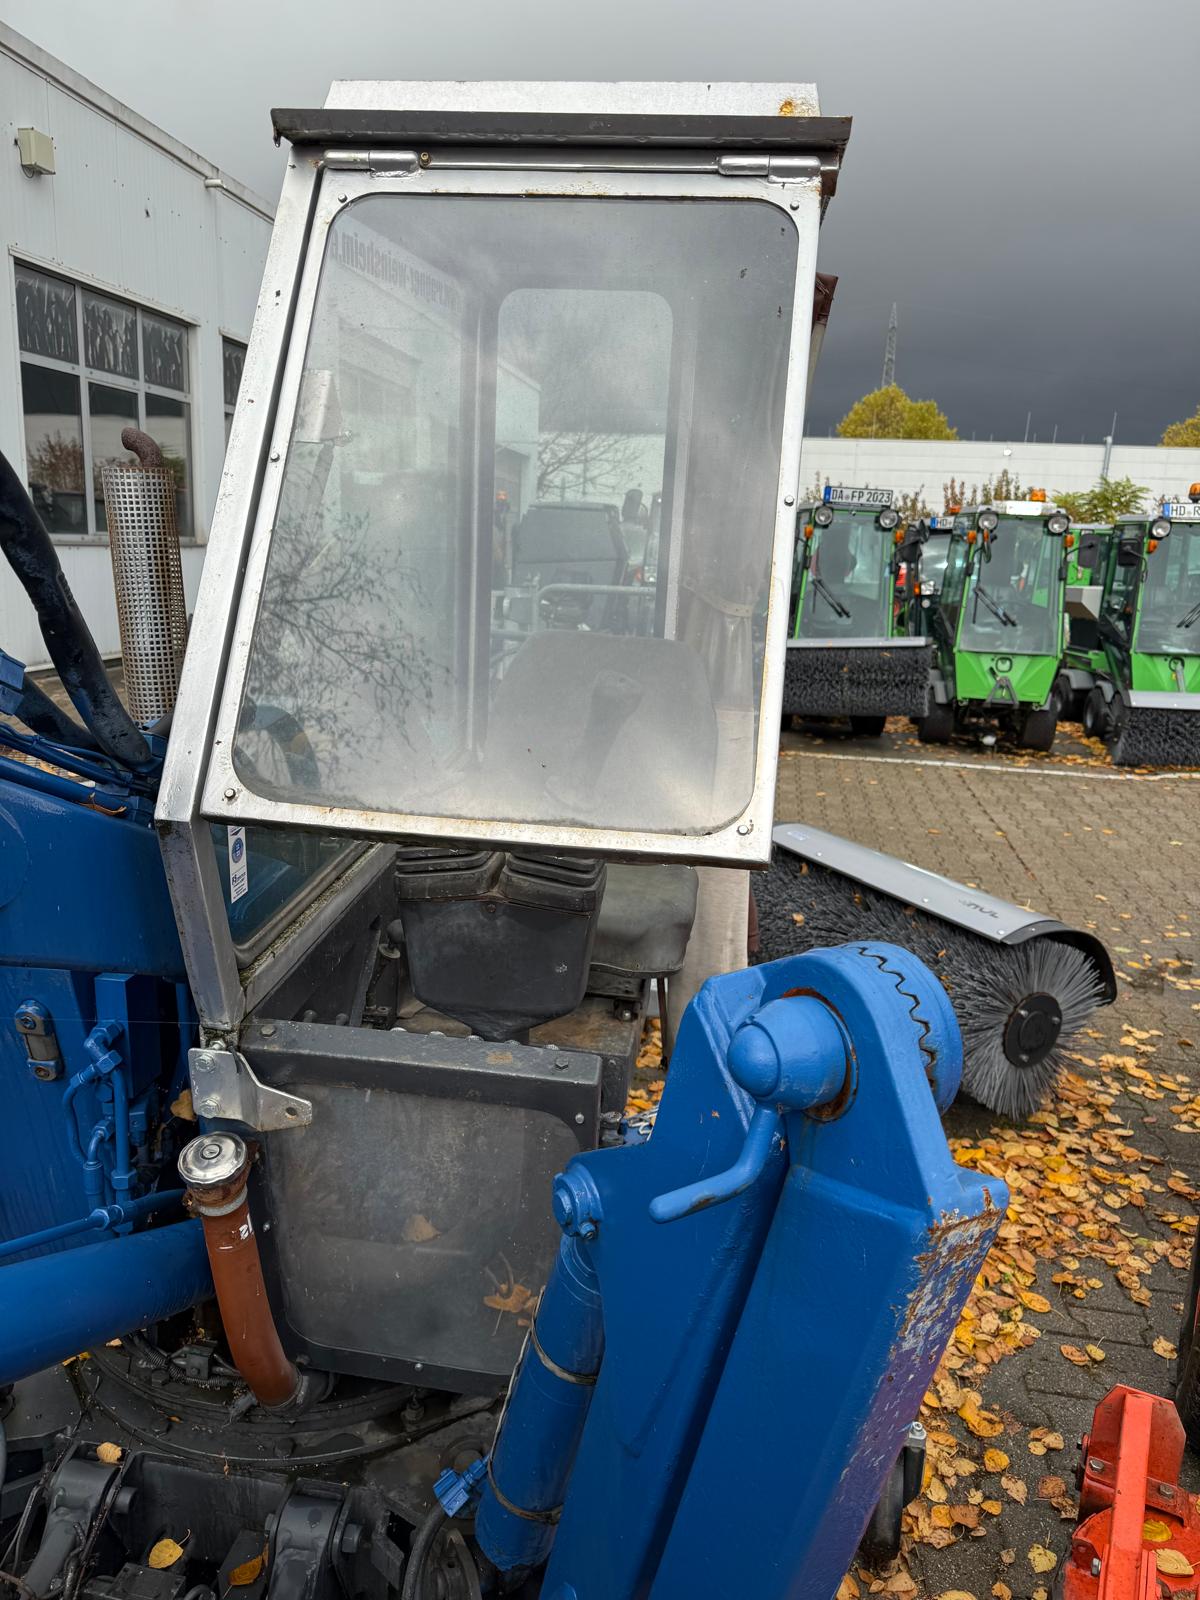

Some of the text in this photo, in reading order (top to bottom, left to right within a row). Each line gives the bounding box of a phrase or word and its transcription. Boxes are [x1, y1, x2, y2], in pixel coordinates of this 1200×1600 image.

[831, 489, 891, 503] DA FP 2023
[1170, 505, 1186, 516] HD
